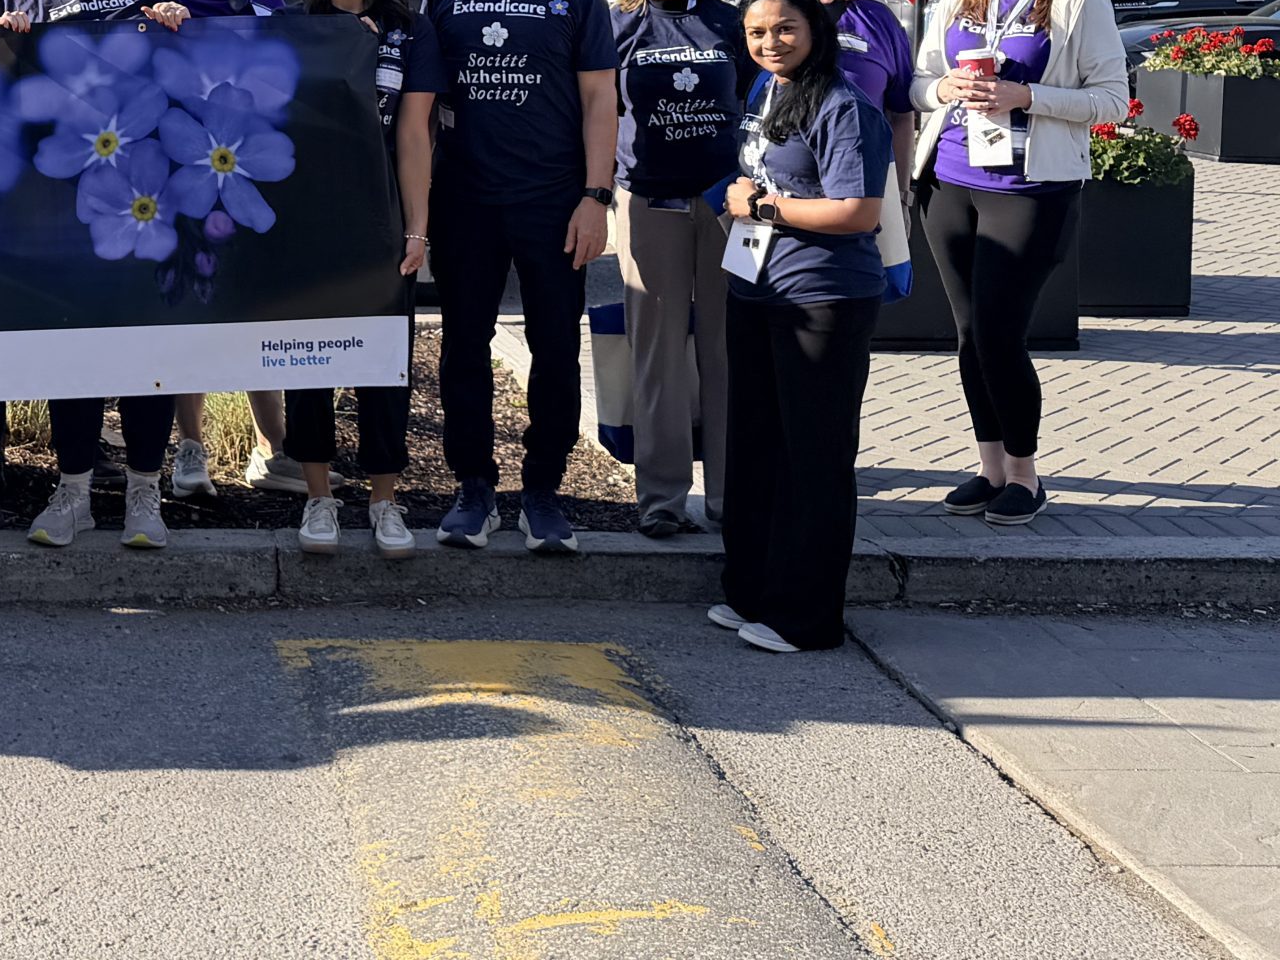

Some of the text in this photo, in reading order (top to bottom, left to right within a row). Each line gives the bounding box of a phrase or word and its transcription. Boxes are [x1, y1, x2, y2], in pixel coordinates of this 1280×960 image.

[453, 0, 546, 15] Extendicare
[468, 53, 528, 68] Société
[636, 48, 728, 66] Extendicare
[457, 70, 542, 84] Alzheimer
[469, 86, 529, 106] Society
[261, 336, 364, 353] Helping people
[261, 353, 331, 367] live better
